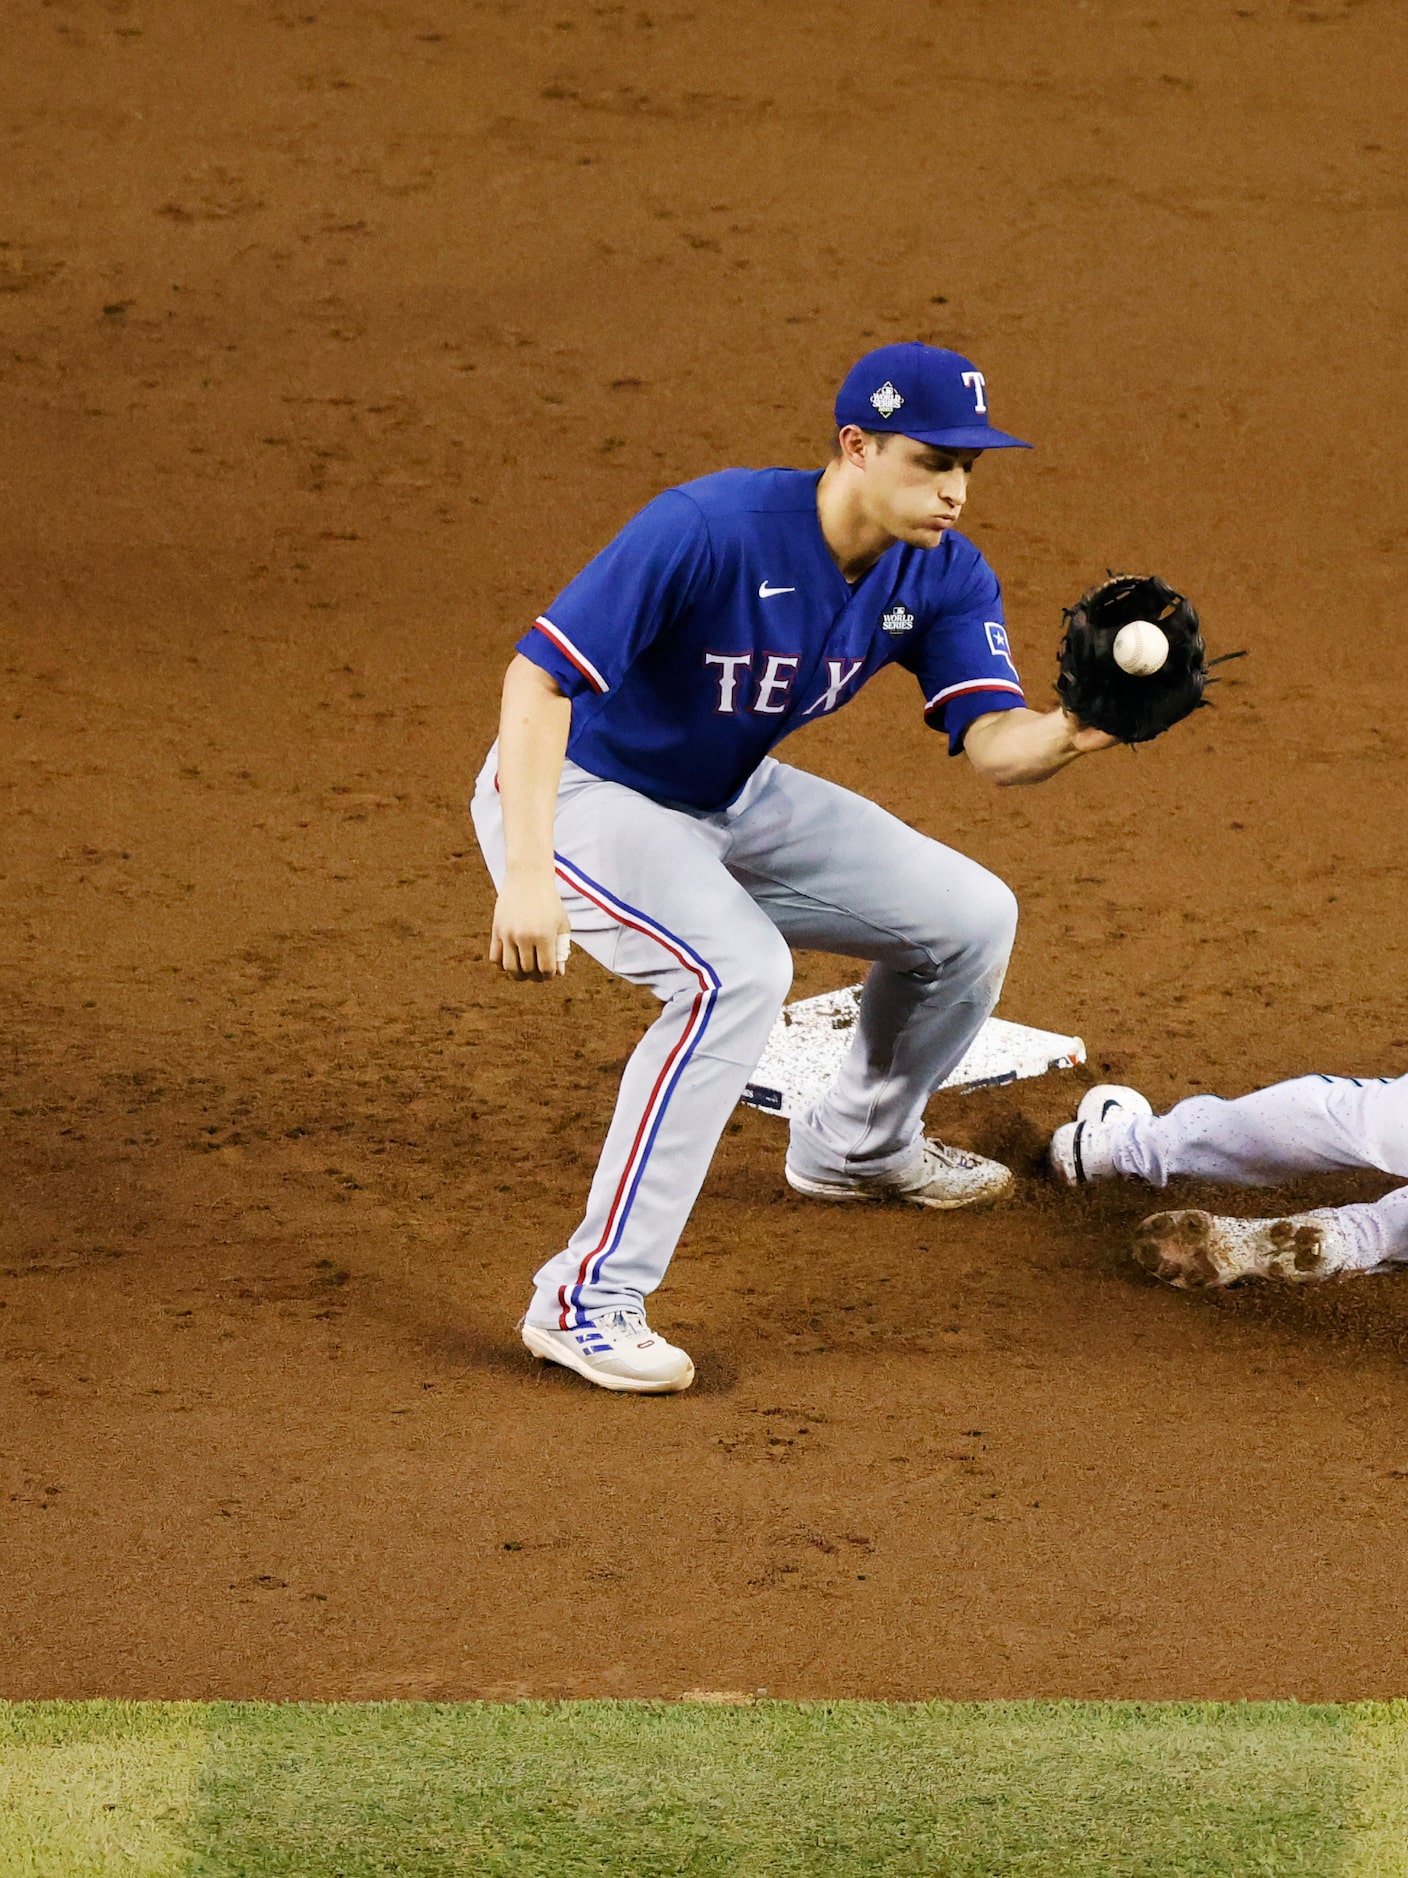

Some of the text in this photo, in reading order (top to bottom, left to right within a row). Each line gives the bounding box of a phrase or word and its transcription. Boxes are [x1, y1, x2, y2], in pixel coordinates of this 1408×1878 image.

[961, 371, 987, 415] T
[883, 614, 914, 622] WORLD
[882, 621, 913, 630] SERIES
